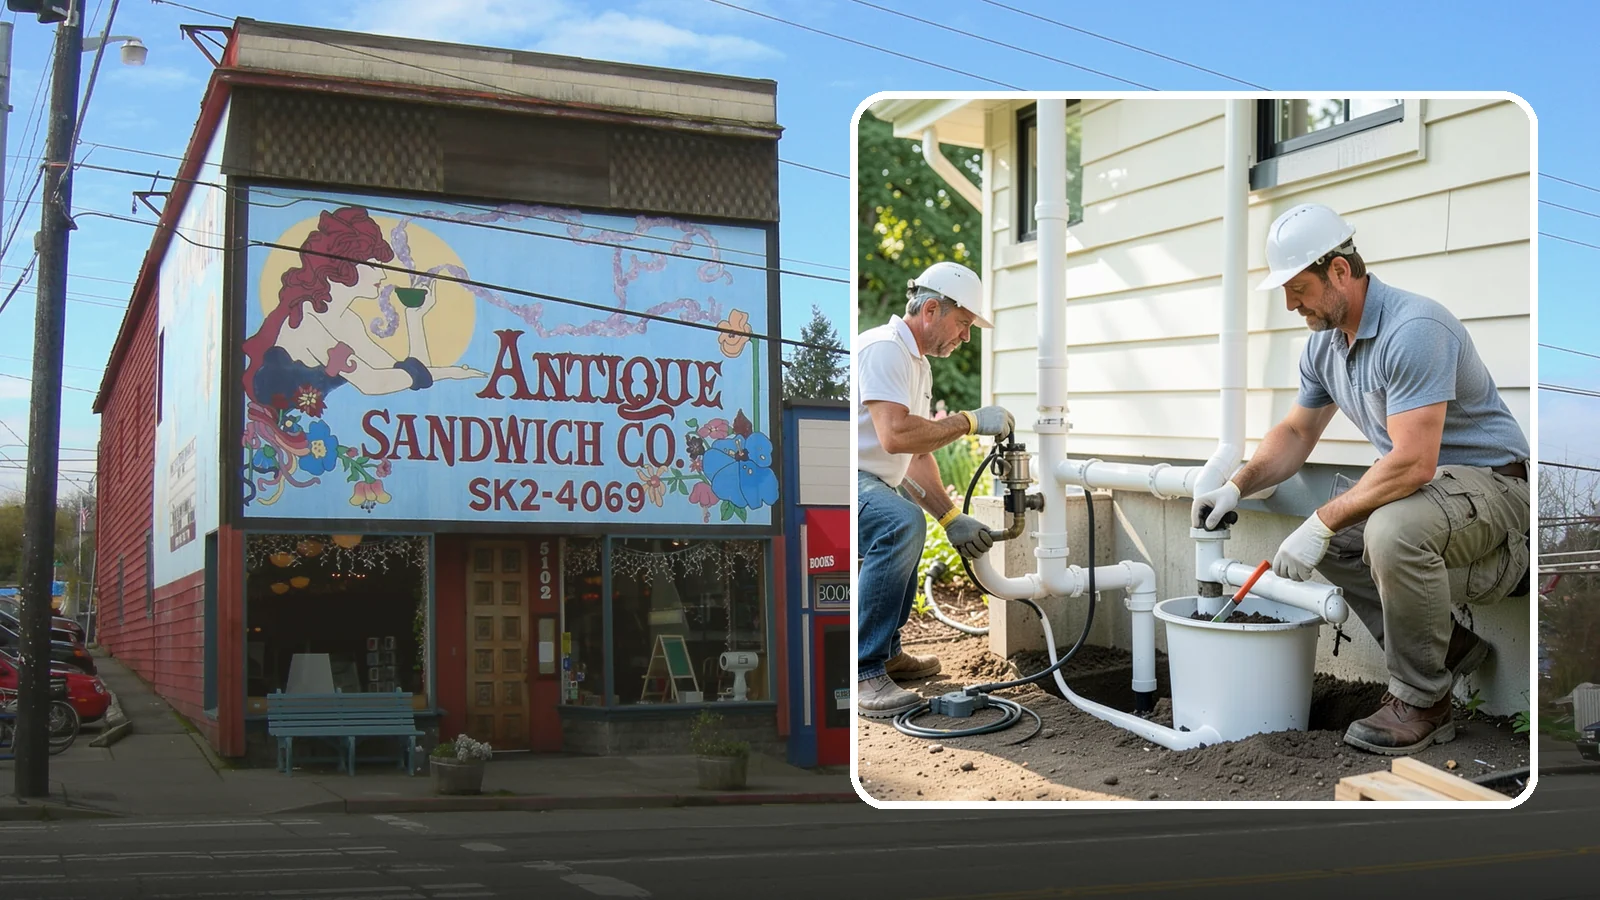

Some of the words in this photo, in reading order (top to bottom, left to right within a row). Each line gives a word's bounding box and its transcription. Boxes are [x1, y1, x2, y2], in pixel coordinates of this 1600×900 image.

[476, 329, 723, 421] ANTIQUE
[361, 408, 604, 467] SANDWICH
[617, 422, 684, 469] CO.
[468, 477, 646, 513] SK2-4069
[539, 542, 552, 599] 5102
[809, 555, 835, 569] BOOKS
